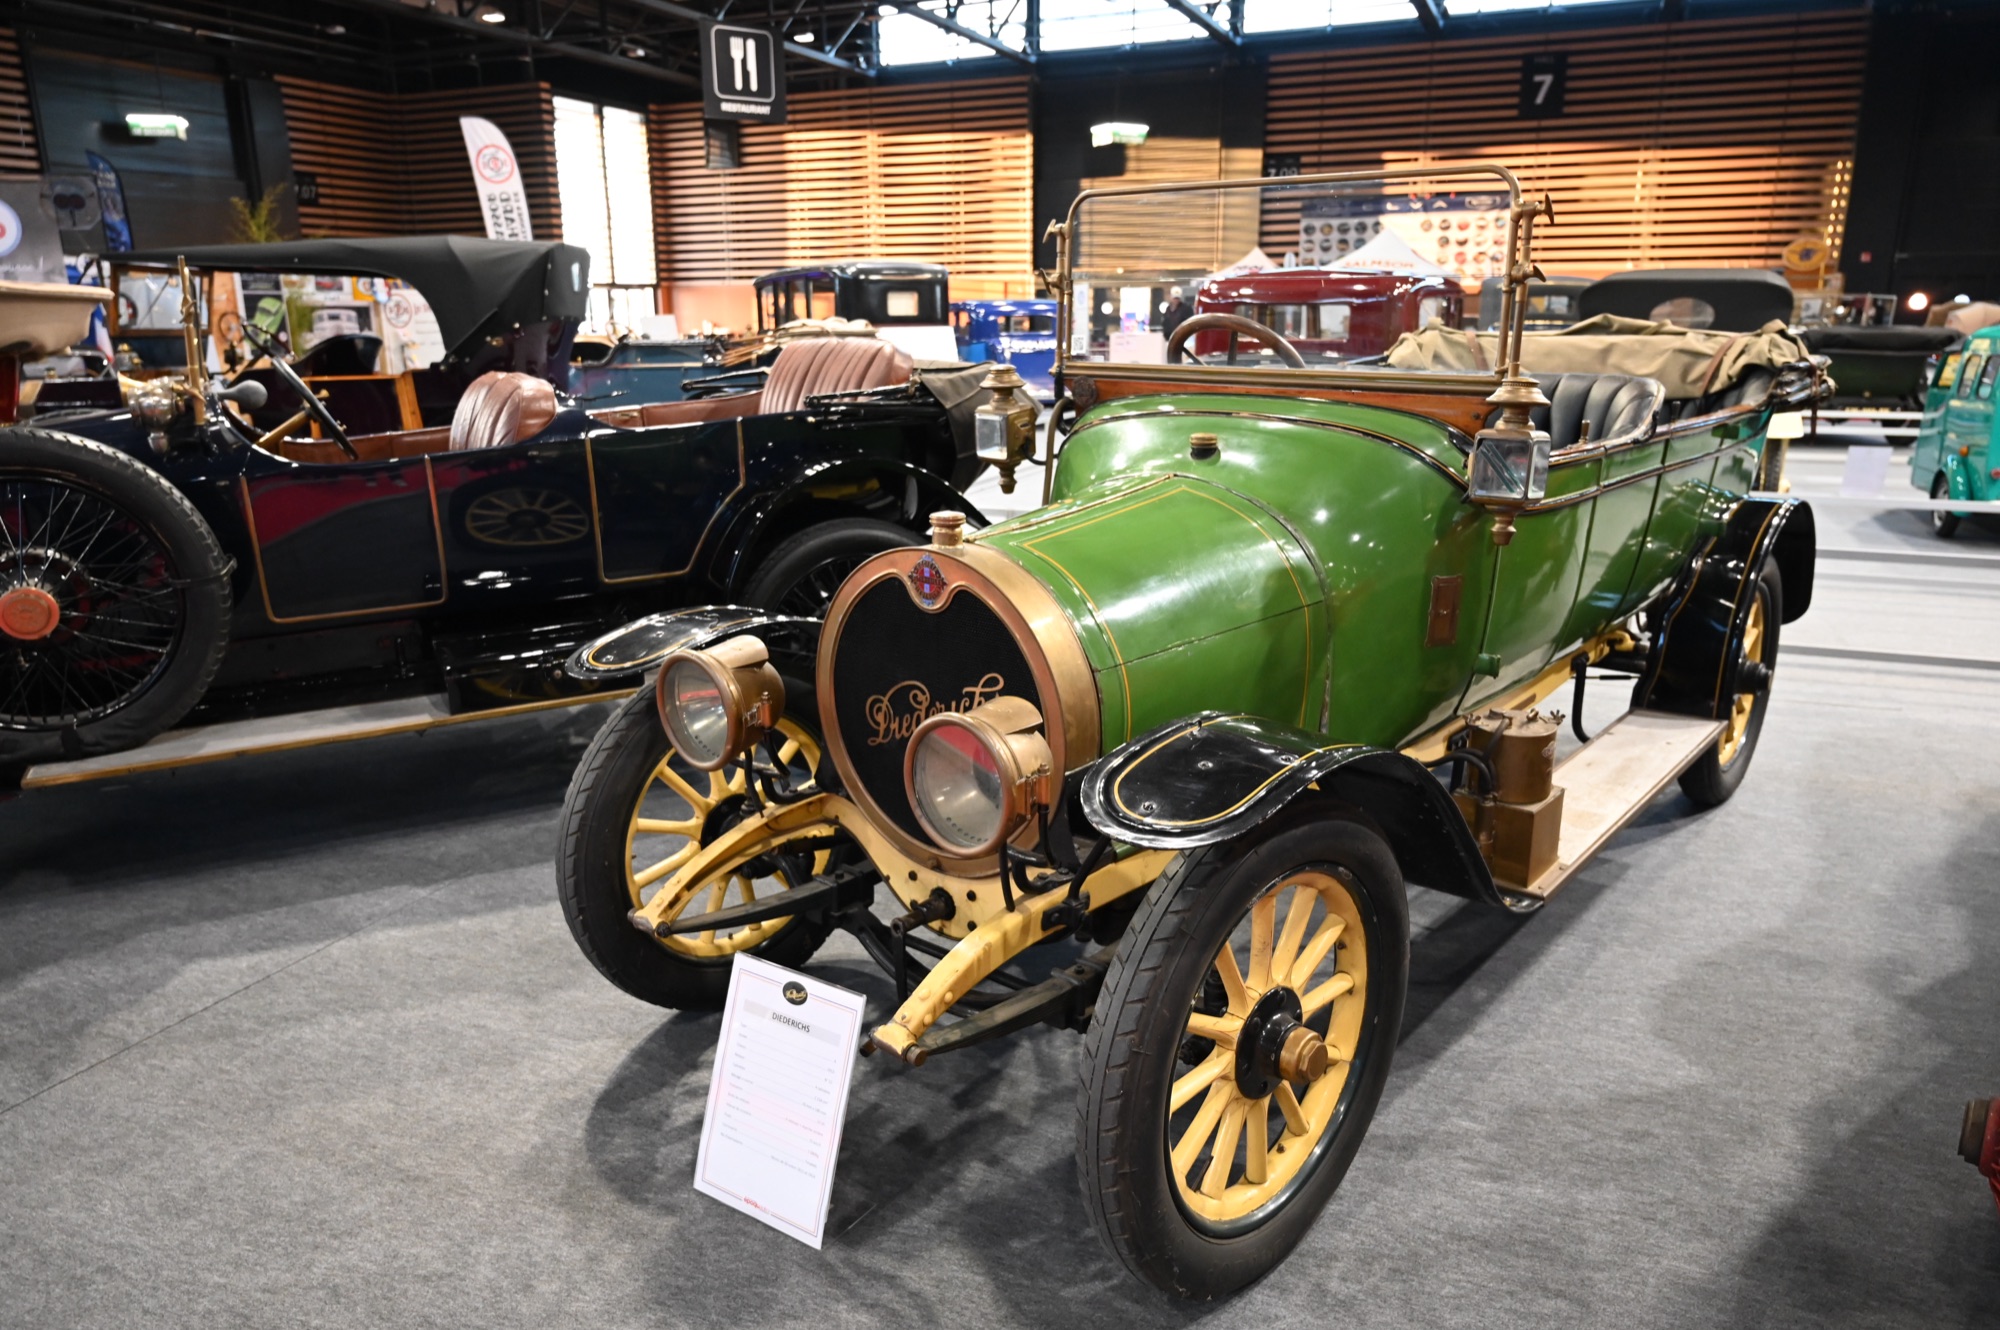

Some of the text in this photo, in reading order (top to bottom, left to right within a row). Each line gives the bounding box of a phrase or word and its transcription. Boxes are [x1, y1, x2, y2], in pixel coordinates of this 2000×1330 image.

[1532, 74, 1554, 105] 7
[720, 102, 771, 116] RESTAURANT
[865, 673, 1004, 746] Diedrich
[772, 1011, 811, 1033] DIEDERICHS
